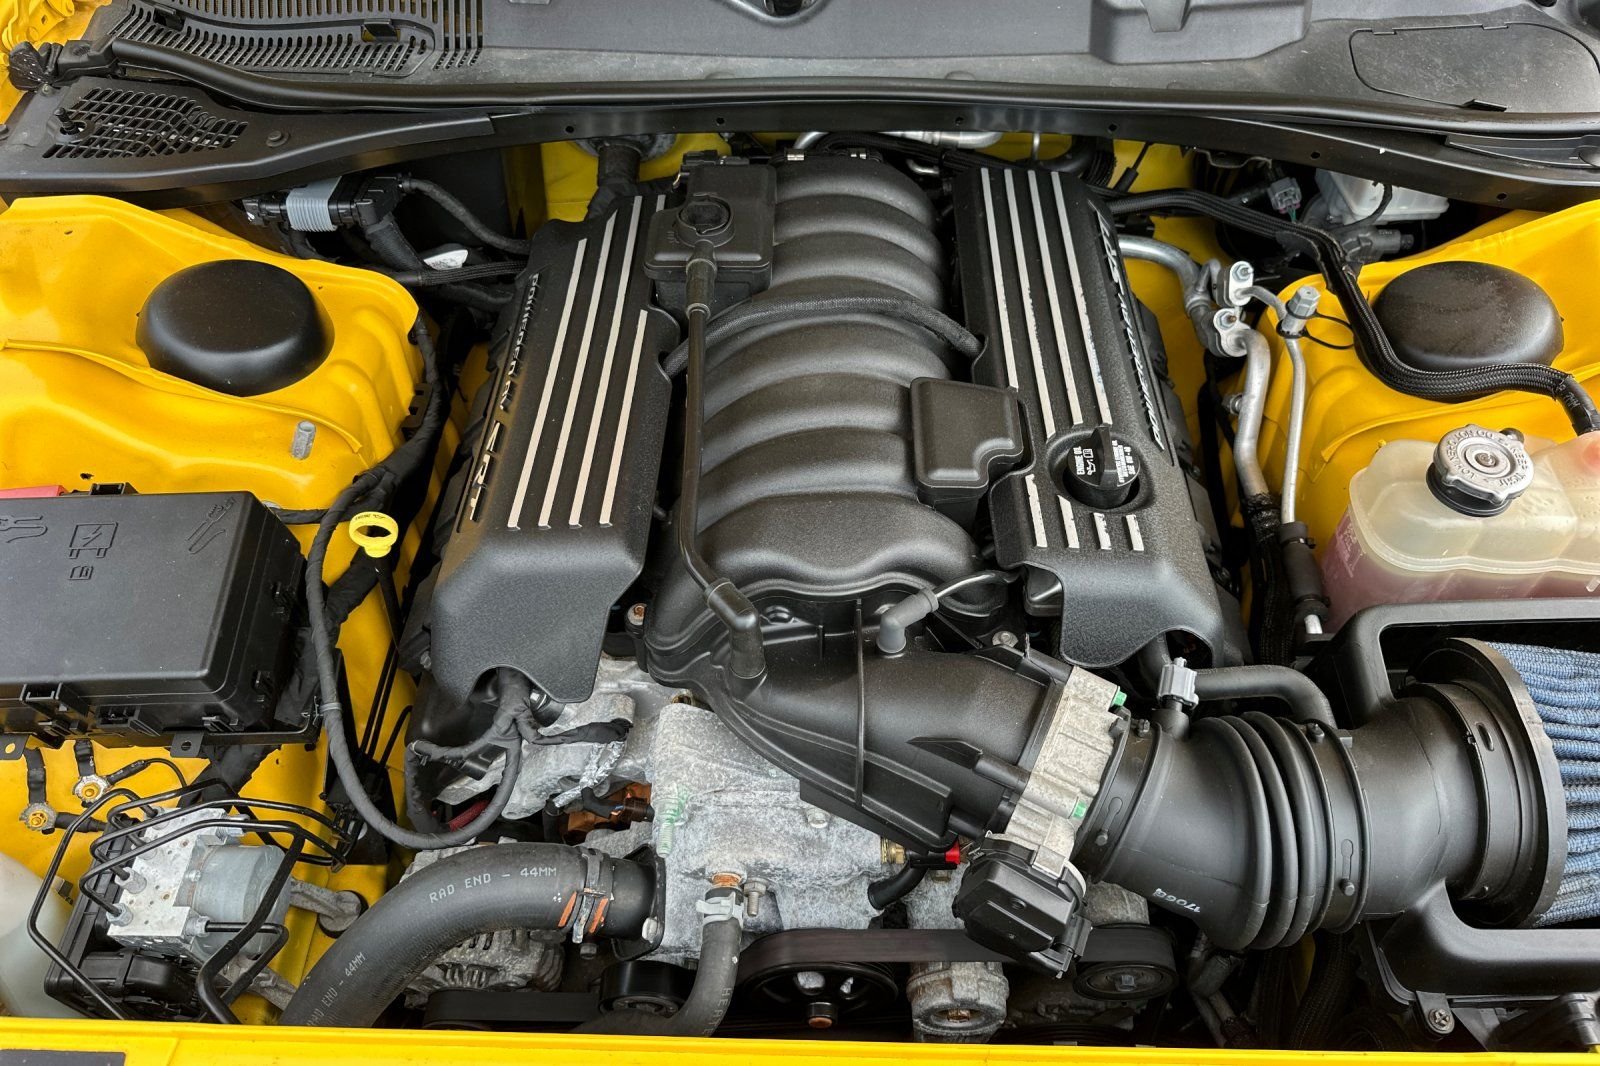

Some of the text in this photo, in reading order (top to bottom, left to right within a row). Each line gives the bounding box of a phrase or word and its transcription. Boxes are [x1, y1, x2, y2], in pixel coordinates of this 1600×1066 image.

[1096, 208, 1125, 297] SRT
[470, 420, 501, 521] SRT
[1073, 446, 1085, 475] ENGINE OIL
[429, 884, 455, 903] RAD
[465, 873, 491, 889] END
[520, 867, 557, 878] 44MM
[345, 951, 366, 977] 44MM
